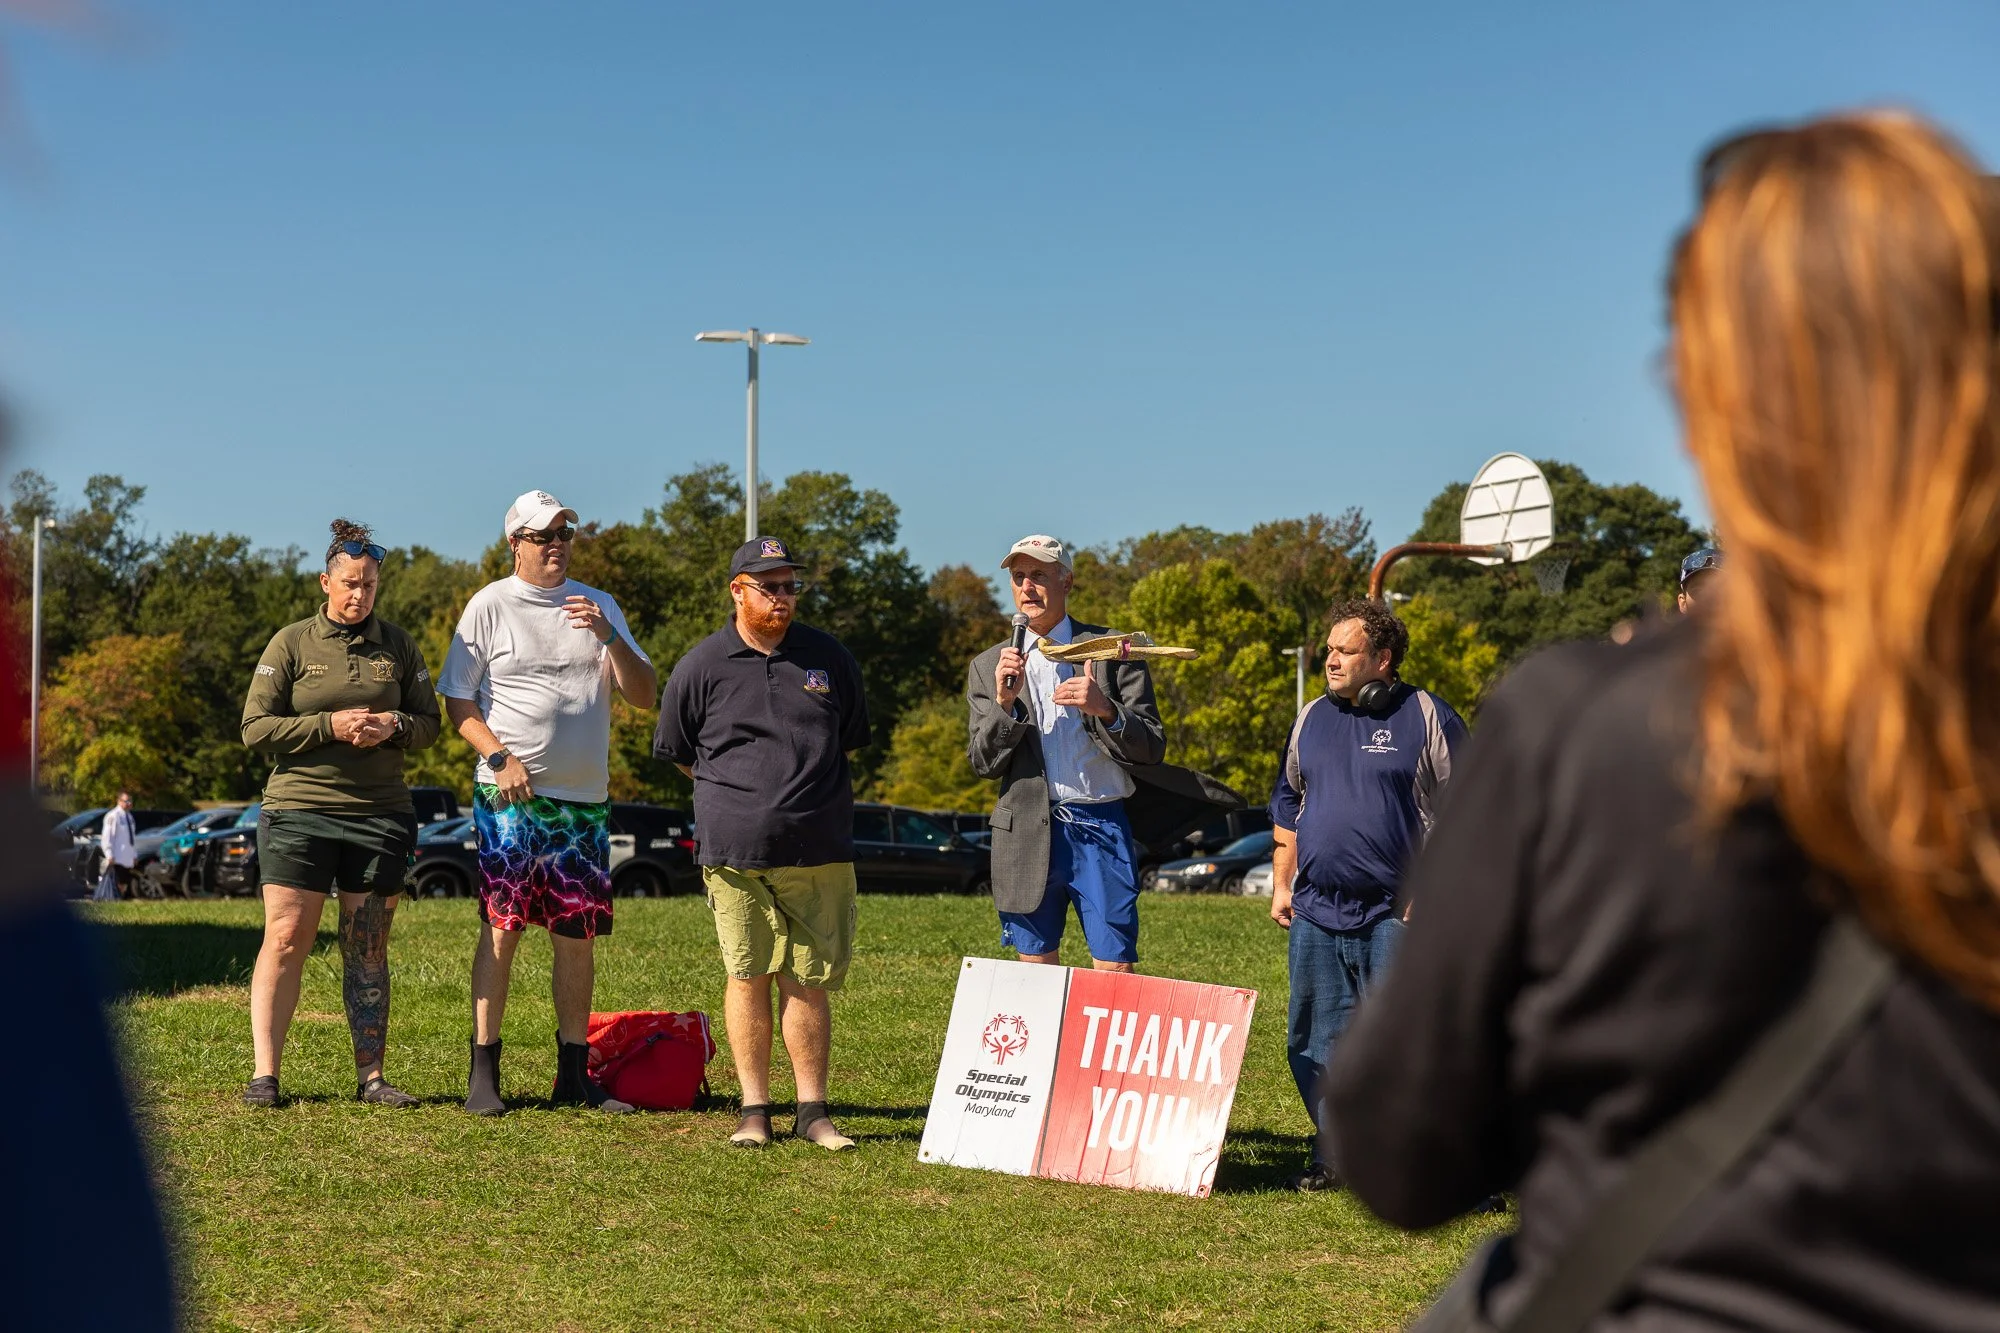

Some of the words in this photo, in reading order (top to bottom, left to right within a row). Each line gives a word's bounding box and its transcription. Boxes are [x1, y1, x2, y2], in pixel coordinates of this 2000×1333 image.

[1080, 1006, 1233, 1084] THANK
[966, 1069, 1028, 1087] Special
[955, 1084, 1031, 1104] Olympics
[964, 1102, 1017, 1118] Maryland
